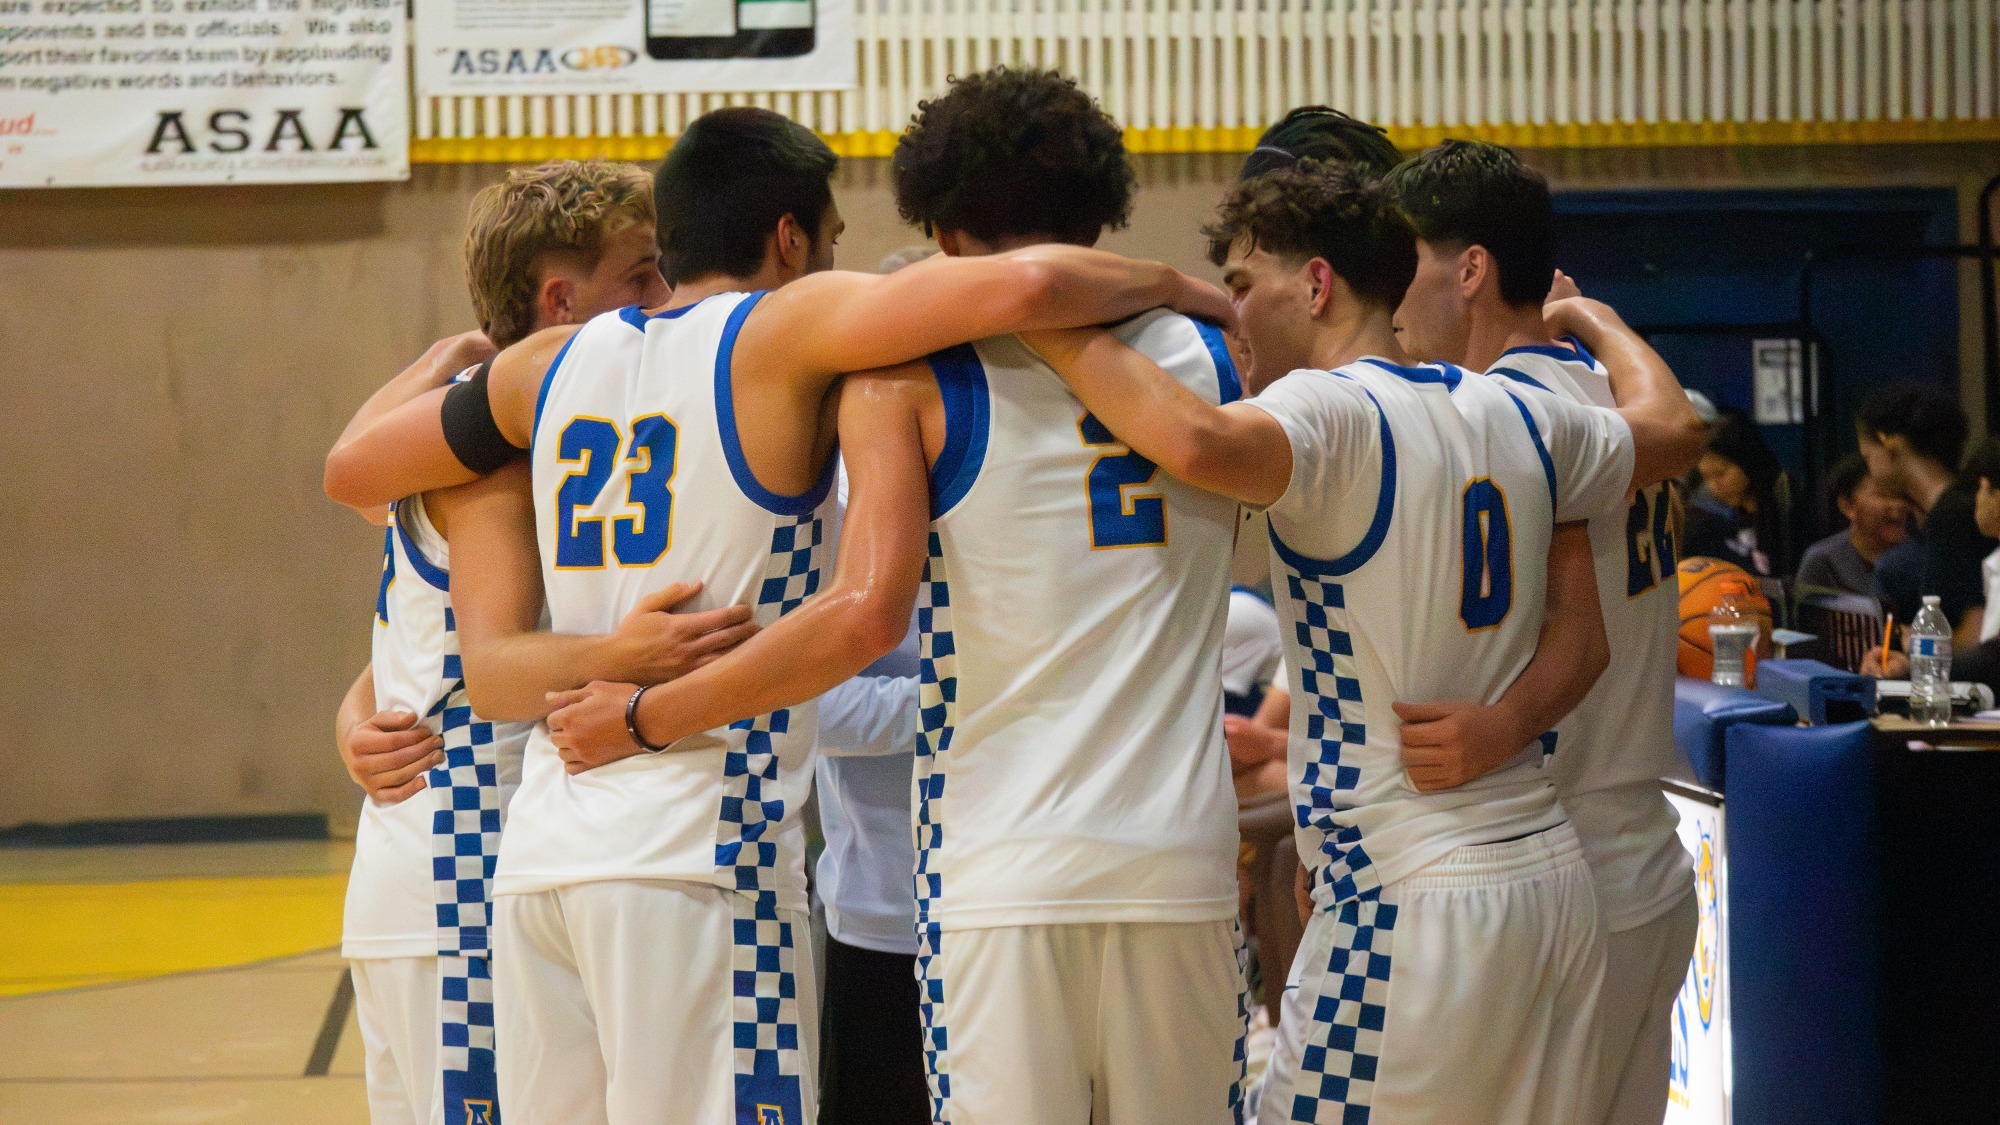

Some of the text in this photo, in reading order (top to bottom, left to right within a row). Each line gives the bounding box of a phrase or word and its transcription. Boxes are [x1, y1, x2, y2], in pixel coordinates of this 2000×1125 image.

[105, 22, 146, 39] and
[152, 21, 187, 38] the
[305, 18, 338, 35] We
[348, 17, 392, 34] also
[46, 48, 94, 64] their
[100, 47, 182, 63] favorite
[185, 46, 240, 62] team
[243, 46, 266, 66] by
[272, 44, 392, 64] applauding
[452, 48, 558, 75] ASAA
[20, 73, 111, 95] negative
[118, 73, 182, 89] words
[188, 72, 228, 88] and
[145, 108, 378, 154] ASAA
[554, 411, 680, 570] 23
[1076, 409, 1168, 551] 2
[1457, 474, 1515, 634] 0
